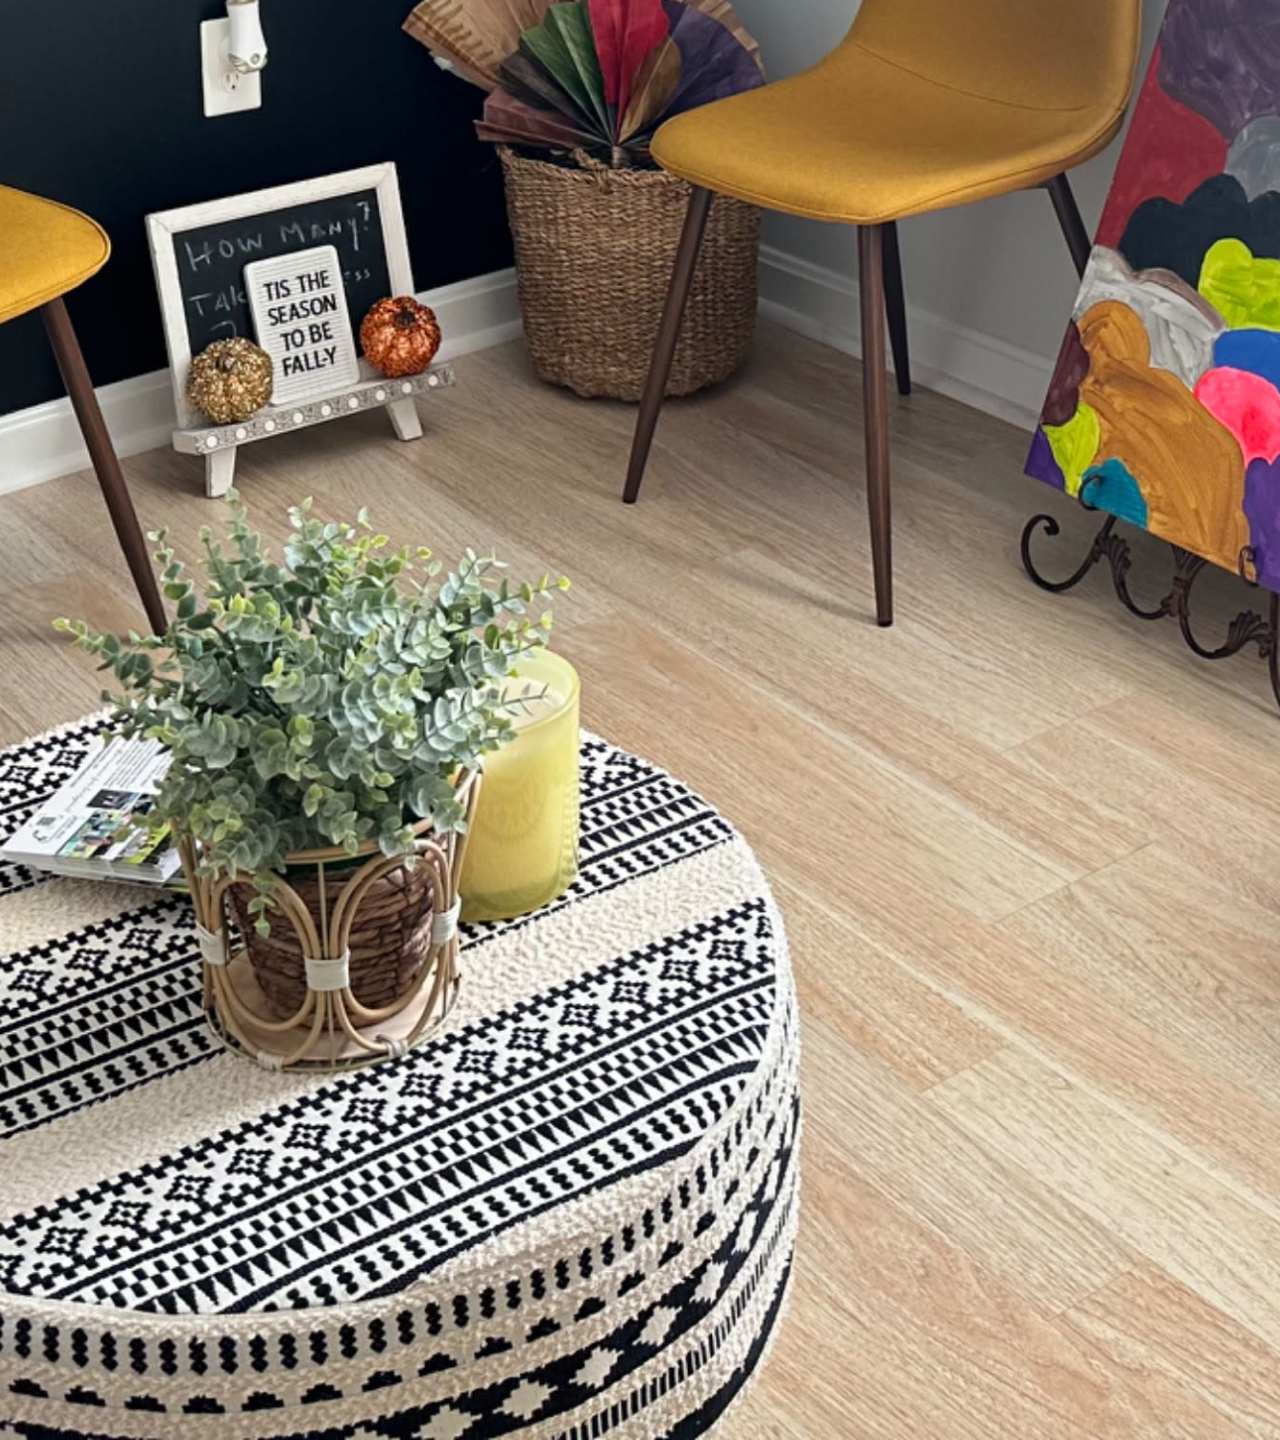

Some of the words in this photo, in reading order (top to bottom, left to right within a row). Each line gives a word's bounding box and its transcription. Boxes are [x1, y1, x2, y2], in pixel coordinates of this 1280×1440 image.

[184, 232, 263, 272] HOW
[263, 279, 291, 301] TIS
[296, 270, 331, 294] THE
[267, 293, 338, 327] SEASON
[280, 328, 305, 352] TO
[308, 321, 334, 344] BE
